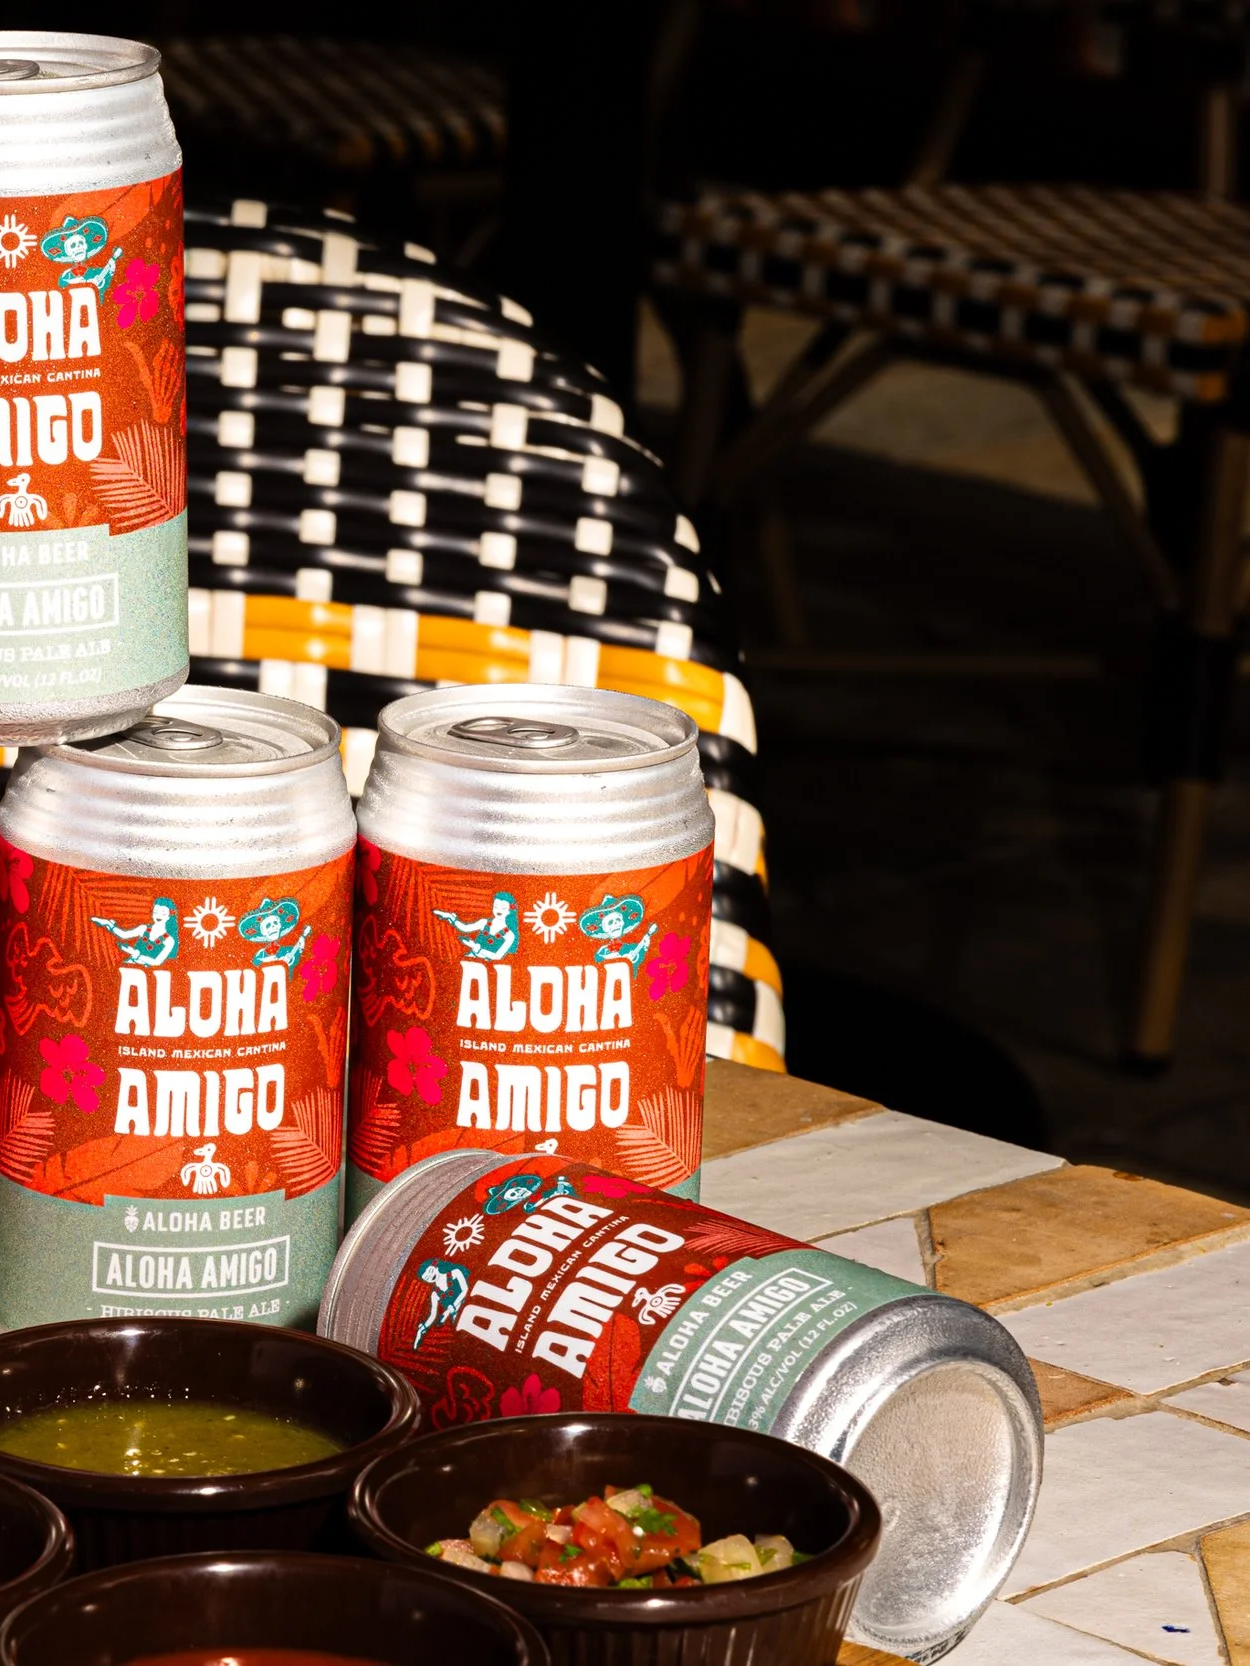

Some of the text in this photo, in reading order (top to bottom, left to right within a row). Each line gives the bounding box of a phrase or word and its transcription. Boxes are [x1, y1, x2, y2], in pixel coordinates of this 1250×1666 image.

[46, 367, 101, 383] CANTINA
[38, 540, 88, 565] BEER
[22, 584, 104, 625] AMIGO
[21, 642, 70, 661] PALE
[74, 639, 112, 658] ALE
[114, 964, 288, 1038] ALOHA
[456, 959, 633, 1033] ALOHA
[118, 1041, 286, 1060] ISLAND MEXICAN CANTINA
[460, 1038, 631, 1055] ISLAND MEXICAN CANTINA
[114, 1063, 285, 1138] AMIGO
[456, 1061, 630, 1133] AMIGO
[143, 1206, 266, 1232] ALOHA BEER
[106, 1247, 277, 1290] ALOHA AMIGO
[455, 1196, 614, 1352] ALOHA
[515, 1215, 630, 1354] ISLAND MEXICAN CANTINA
[248, 1298, 281, 1318] ALE
[531, 1223, 685, 1379] AMIGO
[657, 1269, 753, 1377] ALOHA BEER
[729, 1276, 811, 1339] AMIGO
[761, 1349, 803, 1406] ALC/VOL
[798, 1329, 821, 1350] (12
[816, 1300, 858, 1331] FL.OZ)
[766, 1311, 813, 1352] PALE
